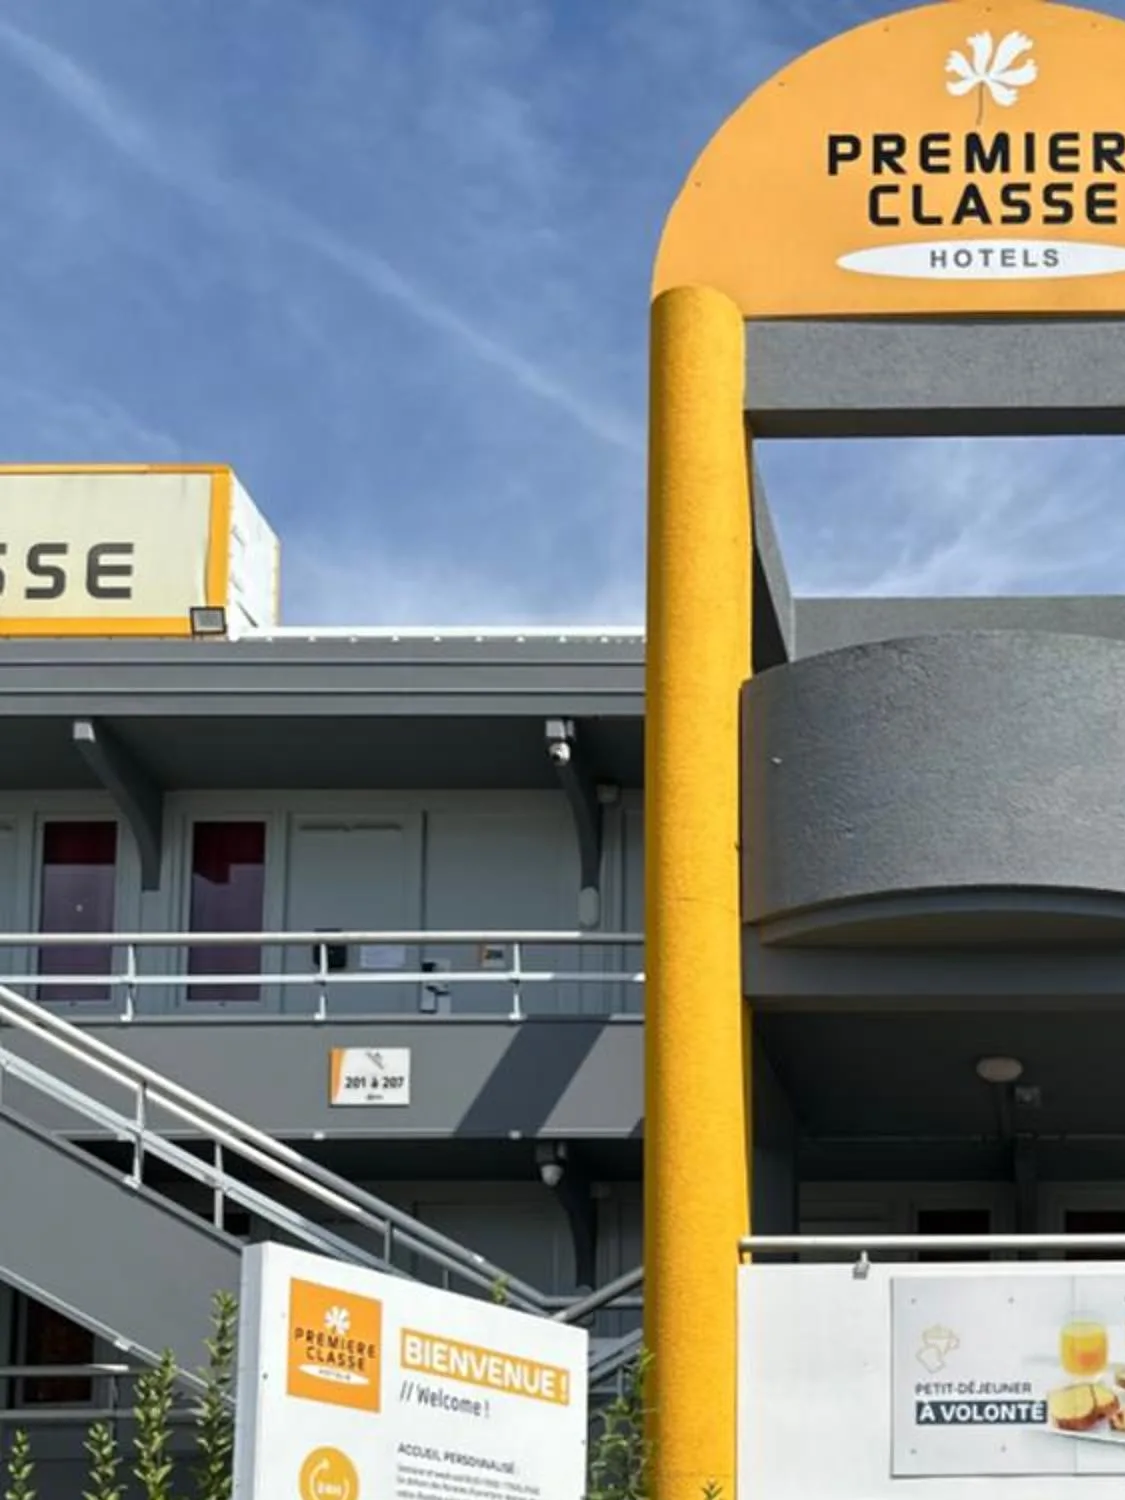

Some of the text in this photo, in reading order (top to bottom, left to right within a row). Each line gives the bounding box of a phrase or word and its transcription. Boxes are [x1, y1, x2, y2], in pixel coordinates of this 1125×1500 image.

[868, 182, 1118, 226] CLASSE
[930, 248, 1060, 268] HOTELS
[0, 542, 134, 600] SE
[294, 1326, 376, 1360] PREMIERE
[305, 1345, 366, 1372] CLASSE
[404, 1335, 556, 1399] BIENVENUE
[416, 1382, 482, 1418] Welcome
[920, 1400, 1045, 1422] À VOLONTÉ
